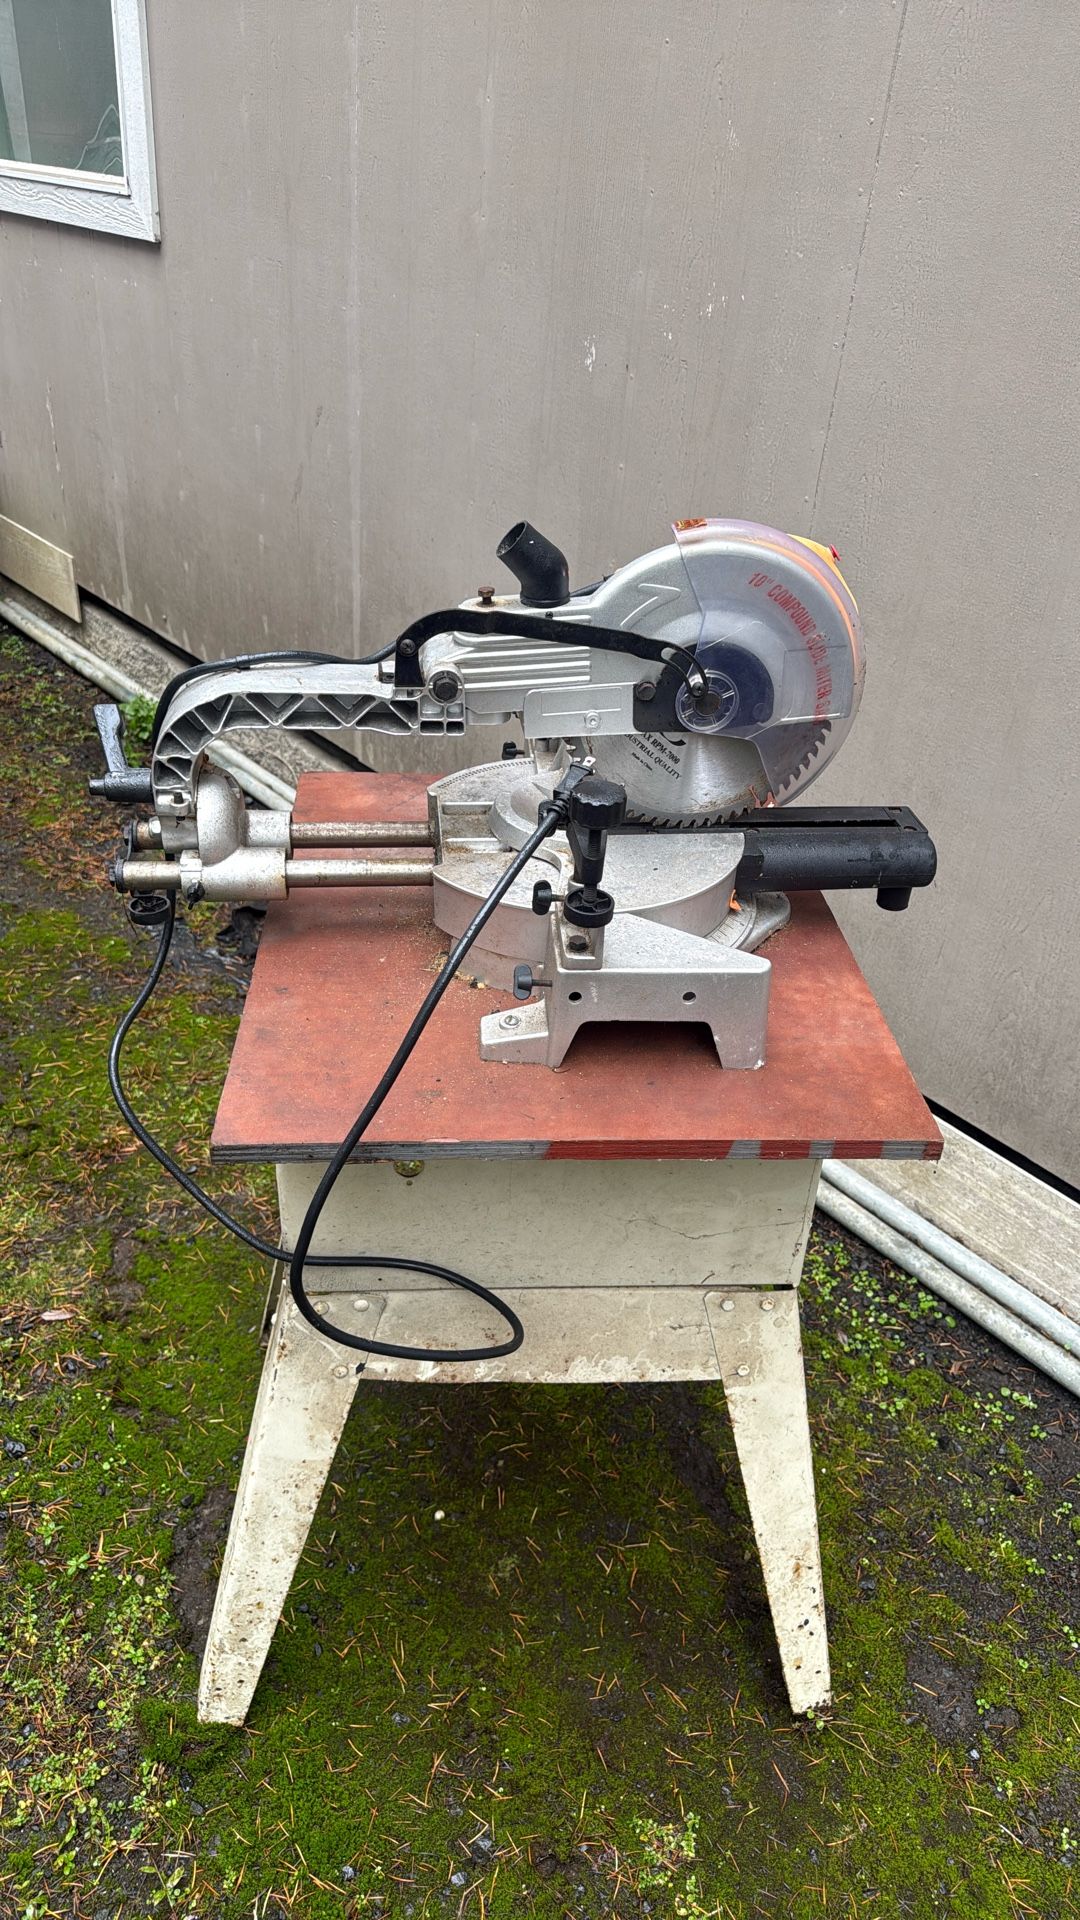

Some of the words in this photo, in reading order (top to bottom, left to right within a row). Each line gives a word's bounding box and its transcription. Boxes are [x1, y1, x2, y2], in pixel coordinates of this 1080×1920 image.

[748, 572, 775, 587] 10"
[767, 584, 817, 636] COMPOUND
[624, 734, 654, 759] DUSTRIAL
[654, 756, 682, 779] QUALITY
[631, 752, 640, 761] Made
[641, 732, 653, 742] AX
[650, 738, 680, 764] RPM-7000
